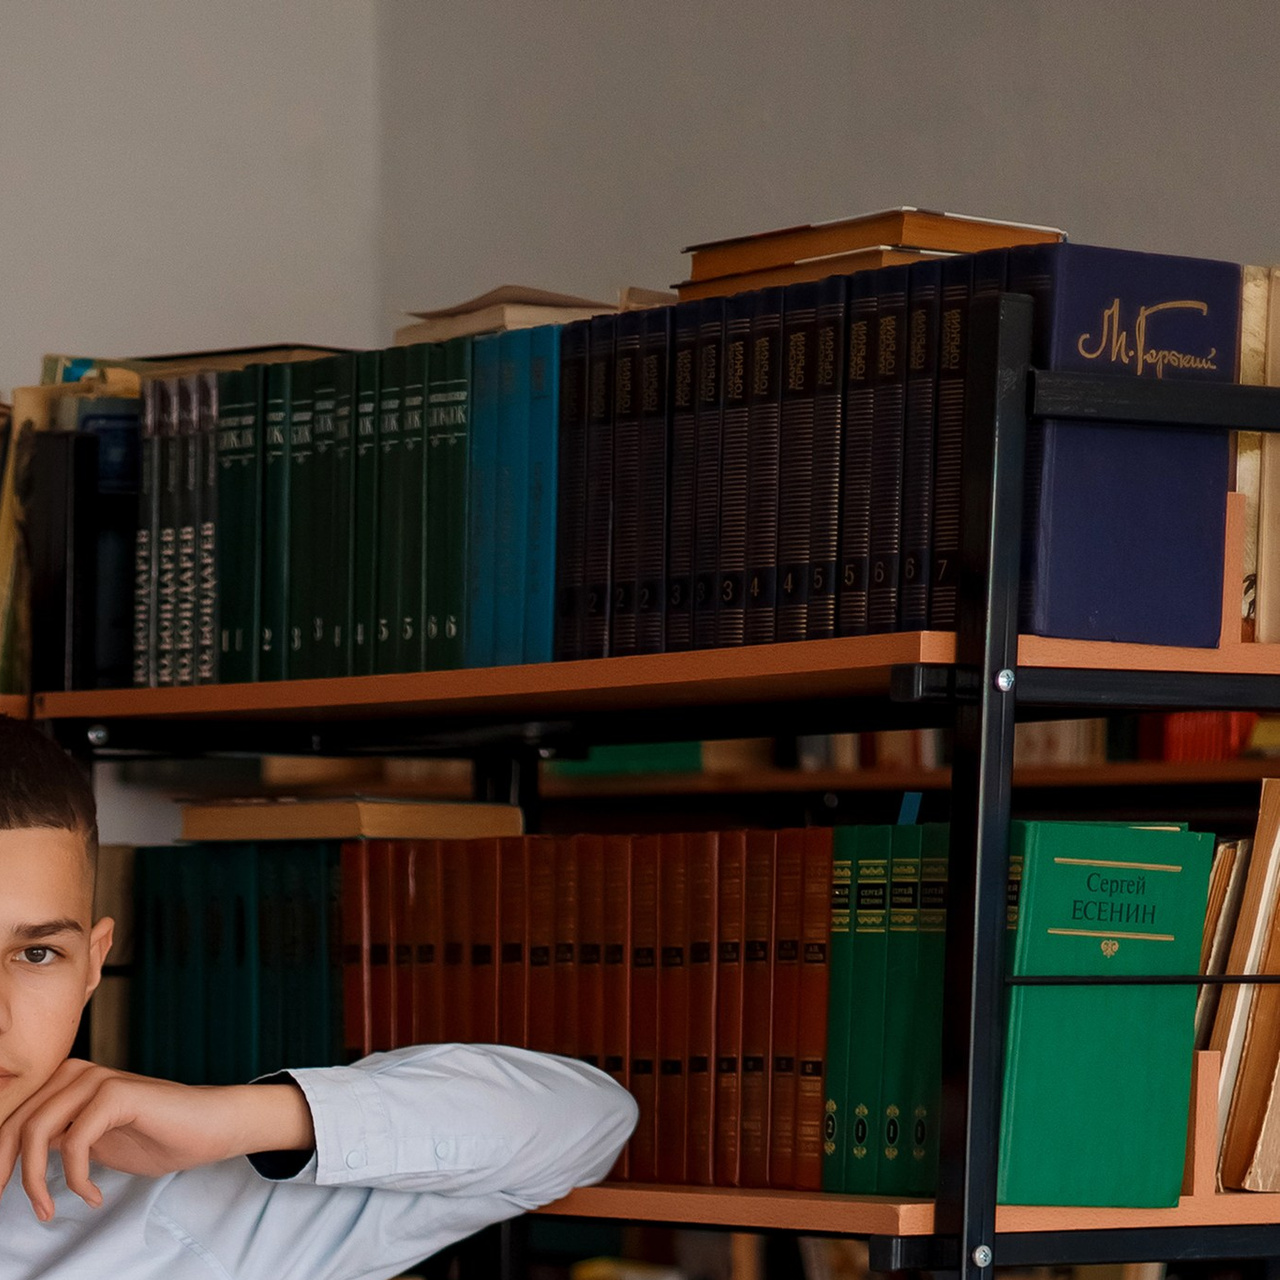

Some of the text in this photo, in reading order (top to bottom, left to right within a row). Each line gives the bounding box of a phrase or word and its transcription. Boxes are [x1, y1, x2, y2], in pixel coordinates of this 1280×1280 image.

[1135, 300, 1217, 379] Горький
[813, 567, 823, 589] 5
[844, 564, 854, 585] 5
[874, 561, 885, 582] 6
[905, 557, 915, 579] 6
[937, 559, 948, 581] 7
[722, 580, 733, 600] 3
[750, 577, 760, 597] 4
[783, 572, 793, 594] 4
[640, 588, 650, 608] 2
[672, 585, 681, 605] 3
[1086, 872, 1146, 897] Сергей
[1071, 899, 1157, 925] ЕСЕНИН
